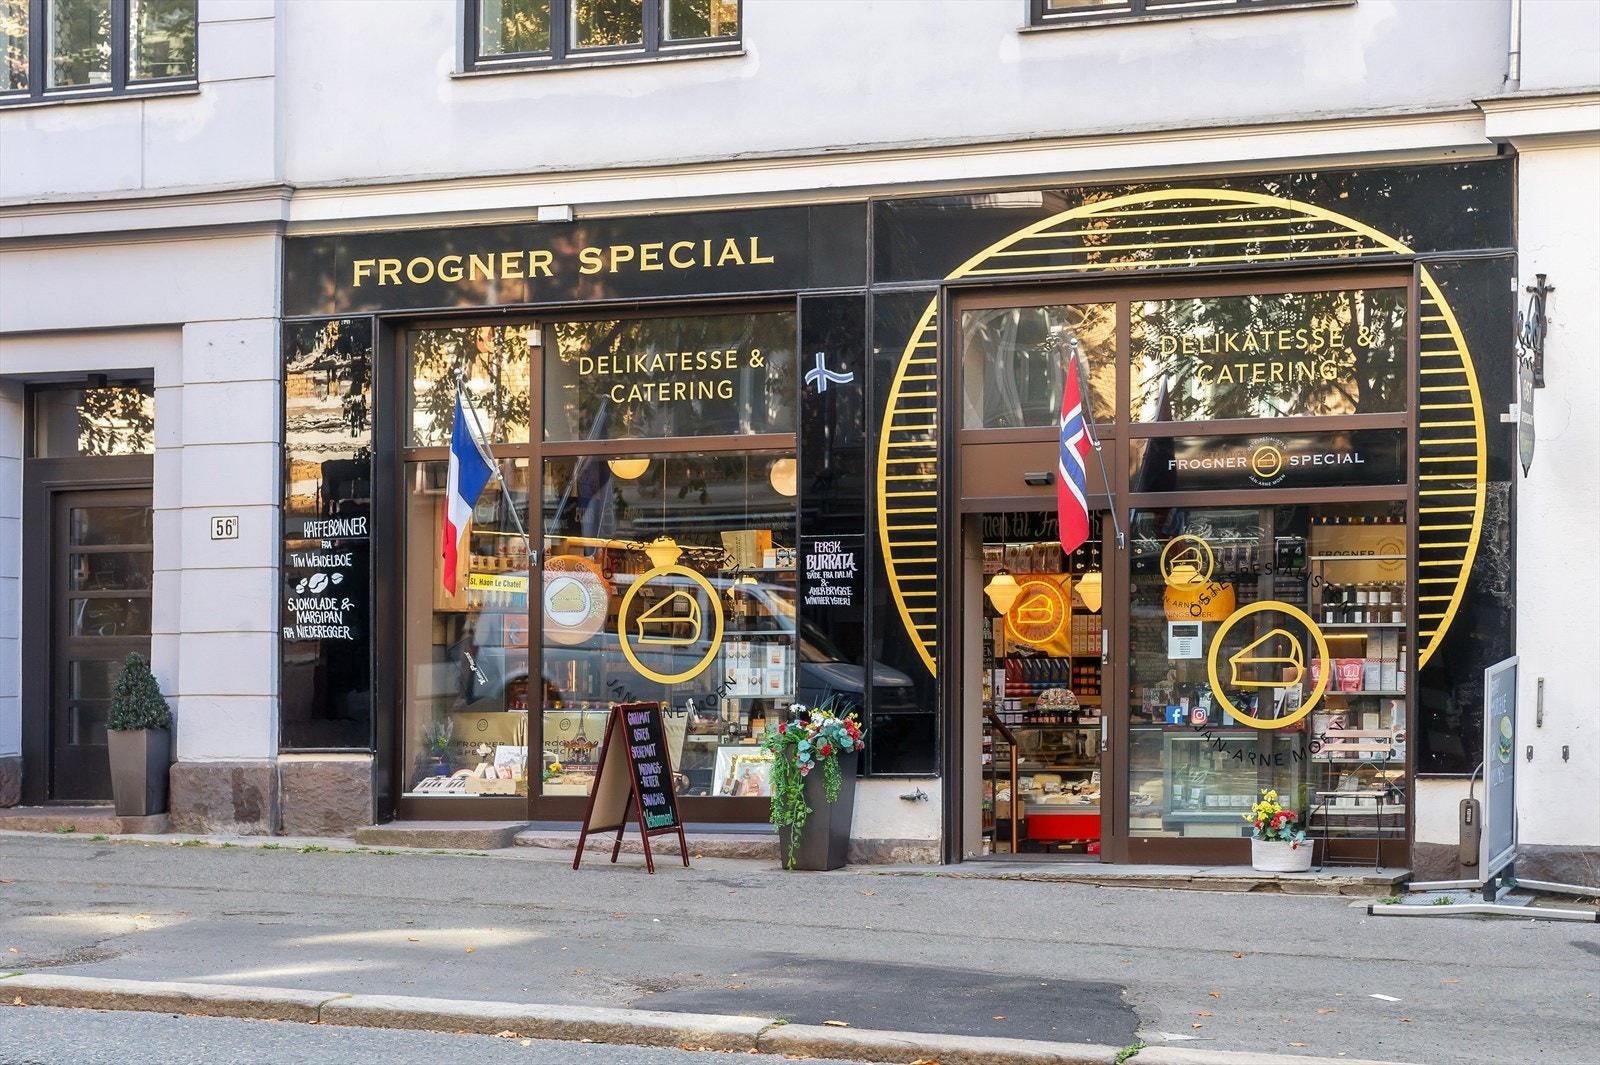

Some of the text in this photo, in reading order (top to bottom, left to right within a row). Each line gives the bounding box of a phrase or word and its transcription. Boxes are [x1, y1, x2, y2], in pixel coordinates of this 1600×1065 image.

[352, 236, 775, 288] FROGNER SPECIAL
[1160, 325, 1375, 356] DELIKATESSE &
[579, 348, 765, 376] DELIKATESSE &
[1198, 360, 1338, 386] CATERING
[611, 380, 734, 404] CATERING
[1168, 452, 1365, 471] FROGNER SPECIAL
[303, 516, 367, 538] KAFFEBØNNER
[321, 540, 332, 549] FRA
[814, 541, 842, 553] FERSK
[290, 552, 353, 568] TIM WENDELBOE
[806, 552, 858, 571] BURRATA
[470, 577, 522, 589] St. Haon Le Chatel
[820, 579, 830, 587] &
[287, 597, 355, 611] SJOKOLADE &
[296, 611, 343, 624] MARSIPAN
[283, 625, 353, 640] FRA NIEDEREGGER
[1195, 724, 1284, 767] JAN-ARNE
